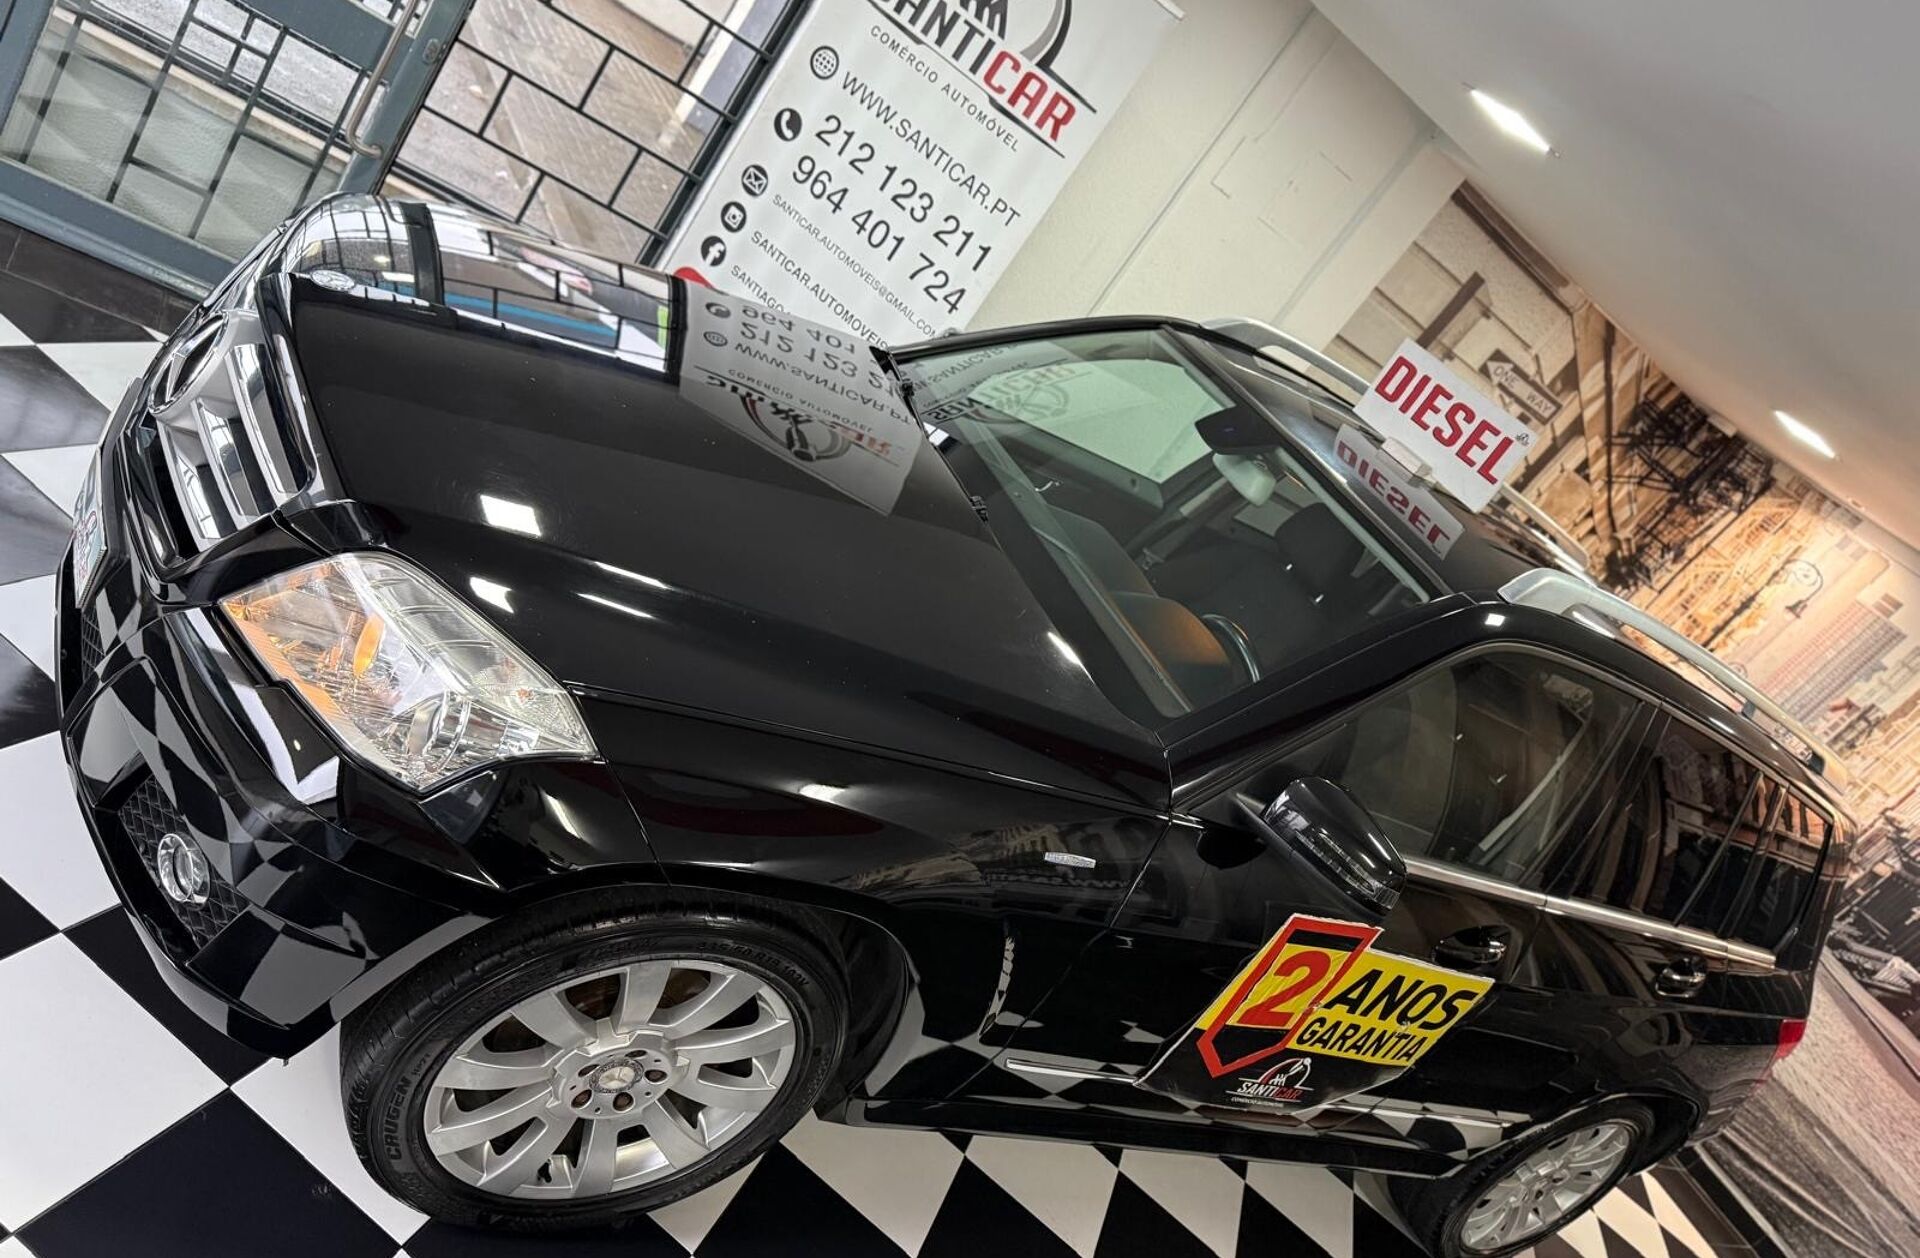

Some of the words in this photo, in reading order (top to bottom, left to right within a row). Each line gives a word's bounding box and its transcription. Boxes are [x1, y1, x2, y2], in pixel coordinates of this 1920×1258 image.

[871, 25, 938, 83] COMÉRCIO
[941, 83, 1019, 152] AUTOMÓVEL
[884, 0, 1076, 144] ANTICAR
[815, 115, 875, 175] 212
[879, 165, 934, 223] 123
[933, 215, 991, 271] 211
[842, 71, 1020, 227] WWW.SANTICAR.PT
[792, 155, 849, 214] 964
[851, 210, 905, 261] 401
[909, 252, 966, 314] 724
[1374, 356, 1516, 485] DIESEL
[1493, 365, 1519, 389] ONE
[1526, 391, 1551, 414] WAY
[1238, 950, 1331, 1027] 2
[1321, 969, 1481, 1031] ANOS
[1295, 1016, 1427, 1063] GARANTIA
[383, 1075, 411, 1160] CRUGEN
[1237, 1081, 1303, 1099] SANTICAR
